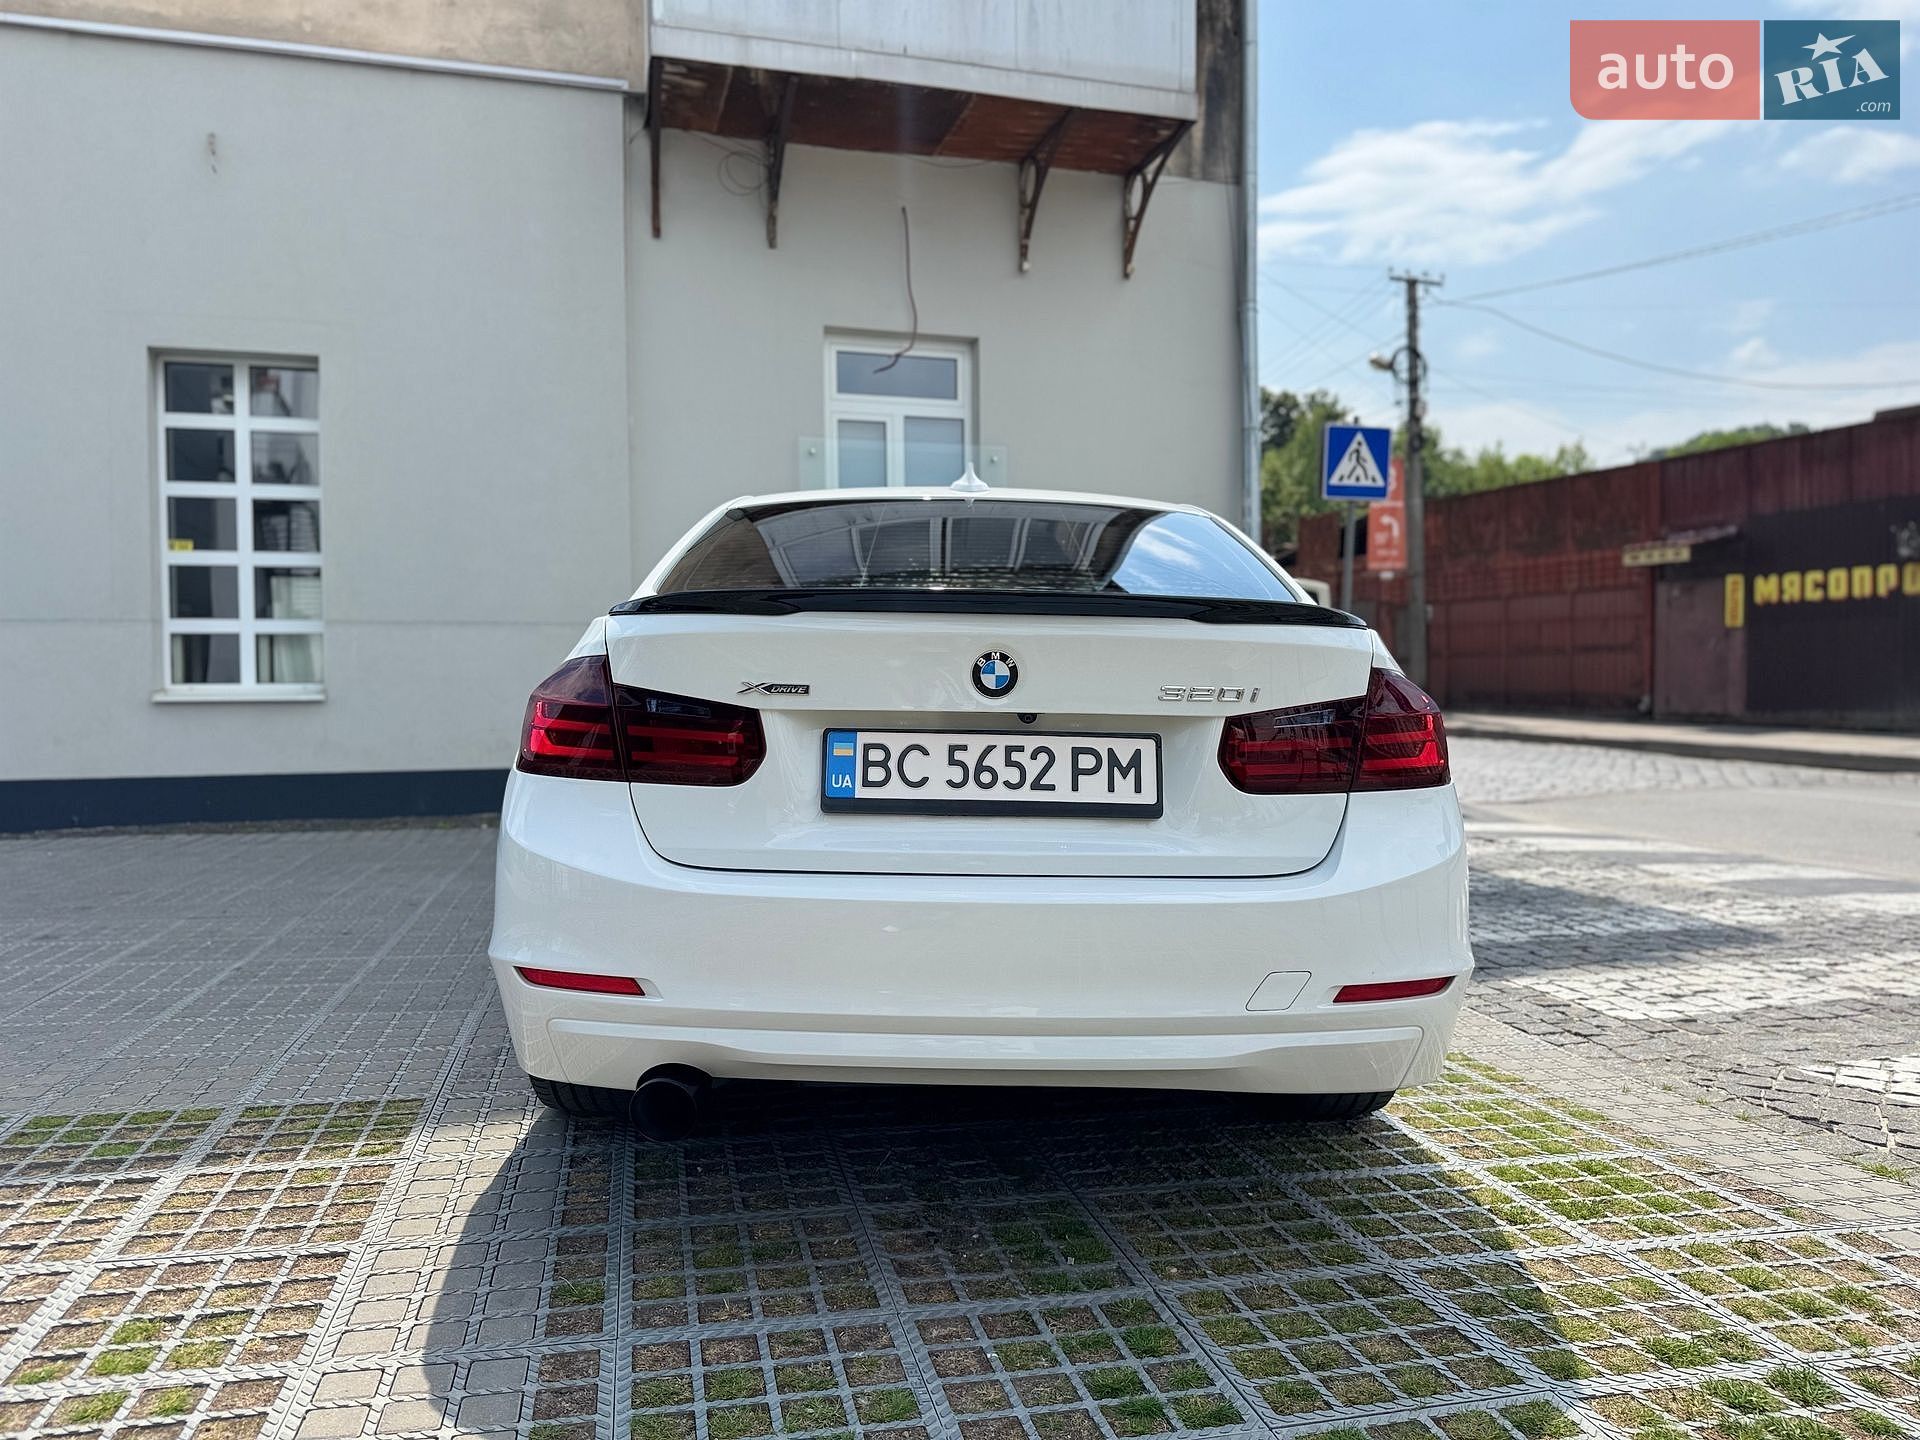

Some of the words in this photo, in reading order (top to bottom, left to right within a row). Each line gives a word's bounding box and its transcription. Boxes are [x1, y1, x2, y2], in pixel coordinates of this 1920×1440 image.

[976, 651, 1016, 668] BMW
[1158, 685, 1261, 703] 320i
[861, 743, 931, 789] BC
[945, 744, 1056, 792] 5652
[1071, 746, 1142, 794] PM
[831, 774, 853, 789] UA
